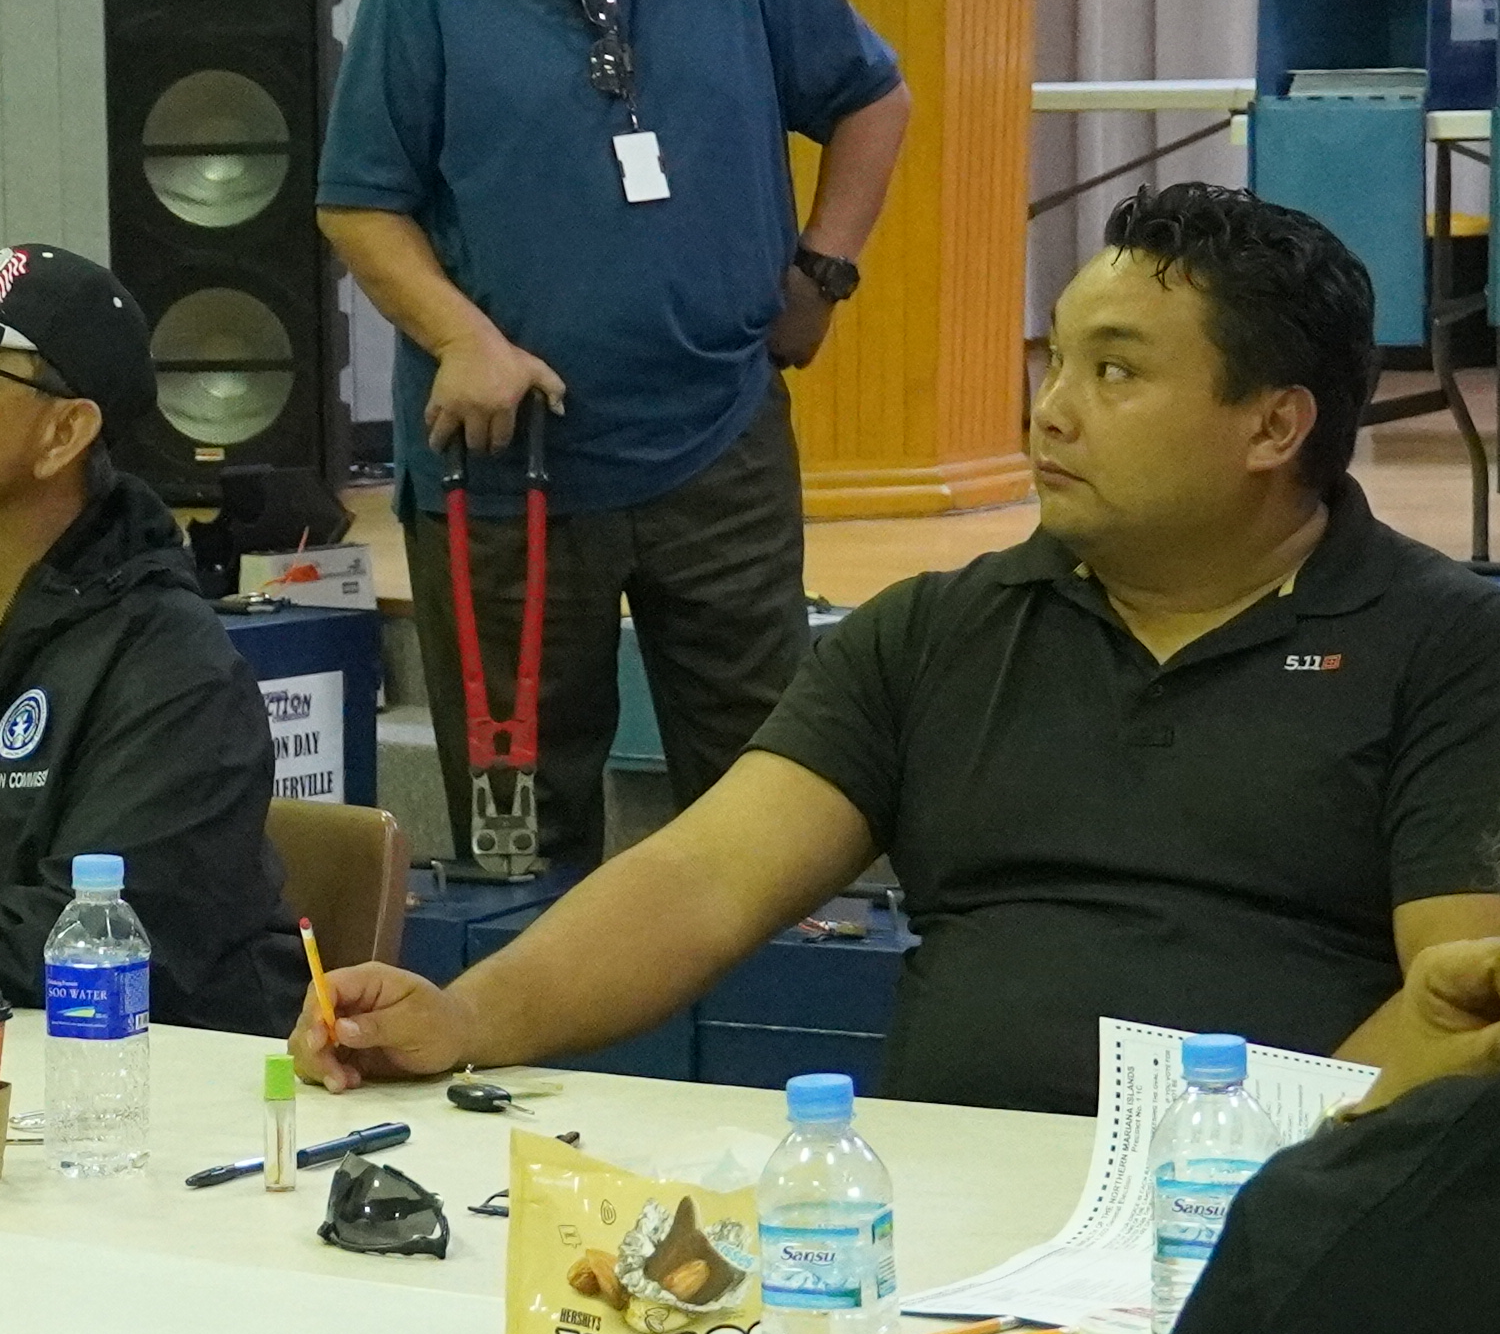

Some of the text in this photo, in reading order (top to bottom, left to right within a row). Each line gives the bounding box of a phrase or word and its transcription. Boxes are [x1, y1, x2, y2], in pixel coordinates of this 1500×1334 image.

[294, 730, 320, 757] DAY
[70, 989, 108, 1001] WATER
[1126, 1066, 1136, 1106] ISLANDS
[1122, 1107, 1134, 1152] MARIANA
[1109, 1153, 1128, 1204] NORTHERN
[780, 1245, 836, 1265] Sansu
[560, 1307, 602, 1331] HERSHEY'S
